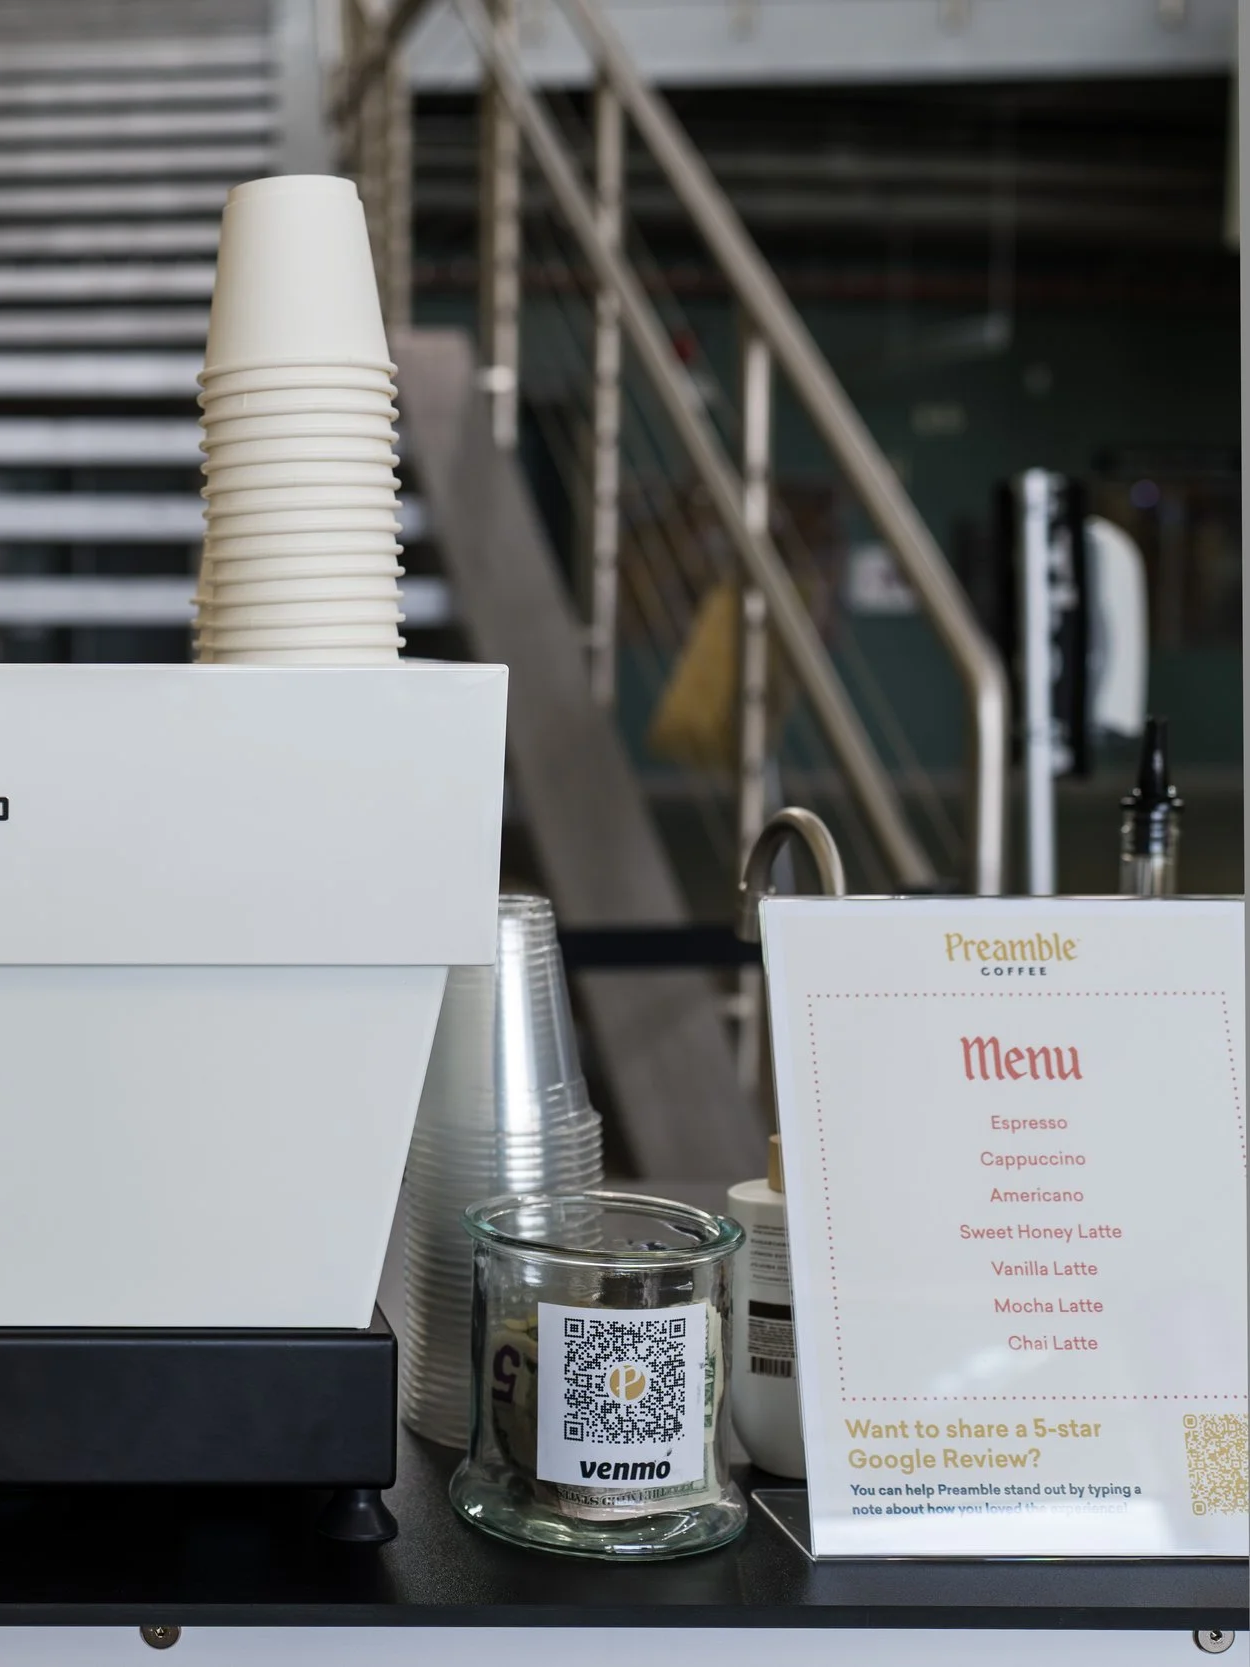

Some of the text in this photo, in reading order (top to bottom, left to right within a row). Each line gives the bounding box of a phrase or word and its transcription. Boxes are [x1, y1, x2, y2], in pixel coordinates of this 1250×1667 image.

[944, 932, 1078, 962] Preamble
[980, 966, 1047, 976] COFFEE
[959, 1035, 1083, 1081] Menu
[990, 1115, 1068, 1134] Espresso
[980, 1151, 1086, 1170] Cappuccino
[990, 1188, 1084, 1203] Americano
[959, 1224, 1122, 1243] Sweet Honey Latte
[991, 1261, 1098, 1276] Vanilla Latte
[994, 1298, 1103, 1313] Mocha Latte
[1007, 1336, 1098, 1351] Chai Latte
[845, 1418, 1102, 1439] Want to share a 5-star
[580, 1460, 670, 1480] venmo
[847, 1448, 1042, 1475] Google Review?
[850, 1483, 1141, 1498] You can help Preamble stand out by typing a
[852, 1505, 882, 1516] note
[886, 1503, 924, 1516] about
[927, 1503, 955, 1515] how
[958, 1505, 982, 1518] you
[985, 1502, 1022, 1515] loved
